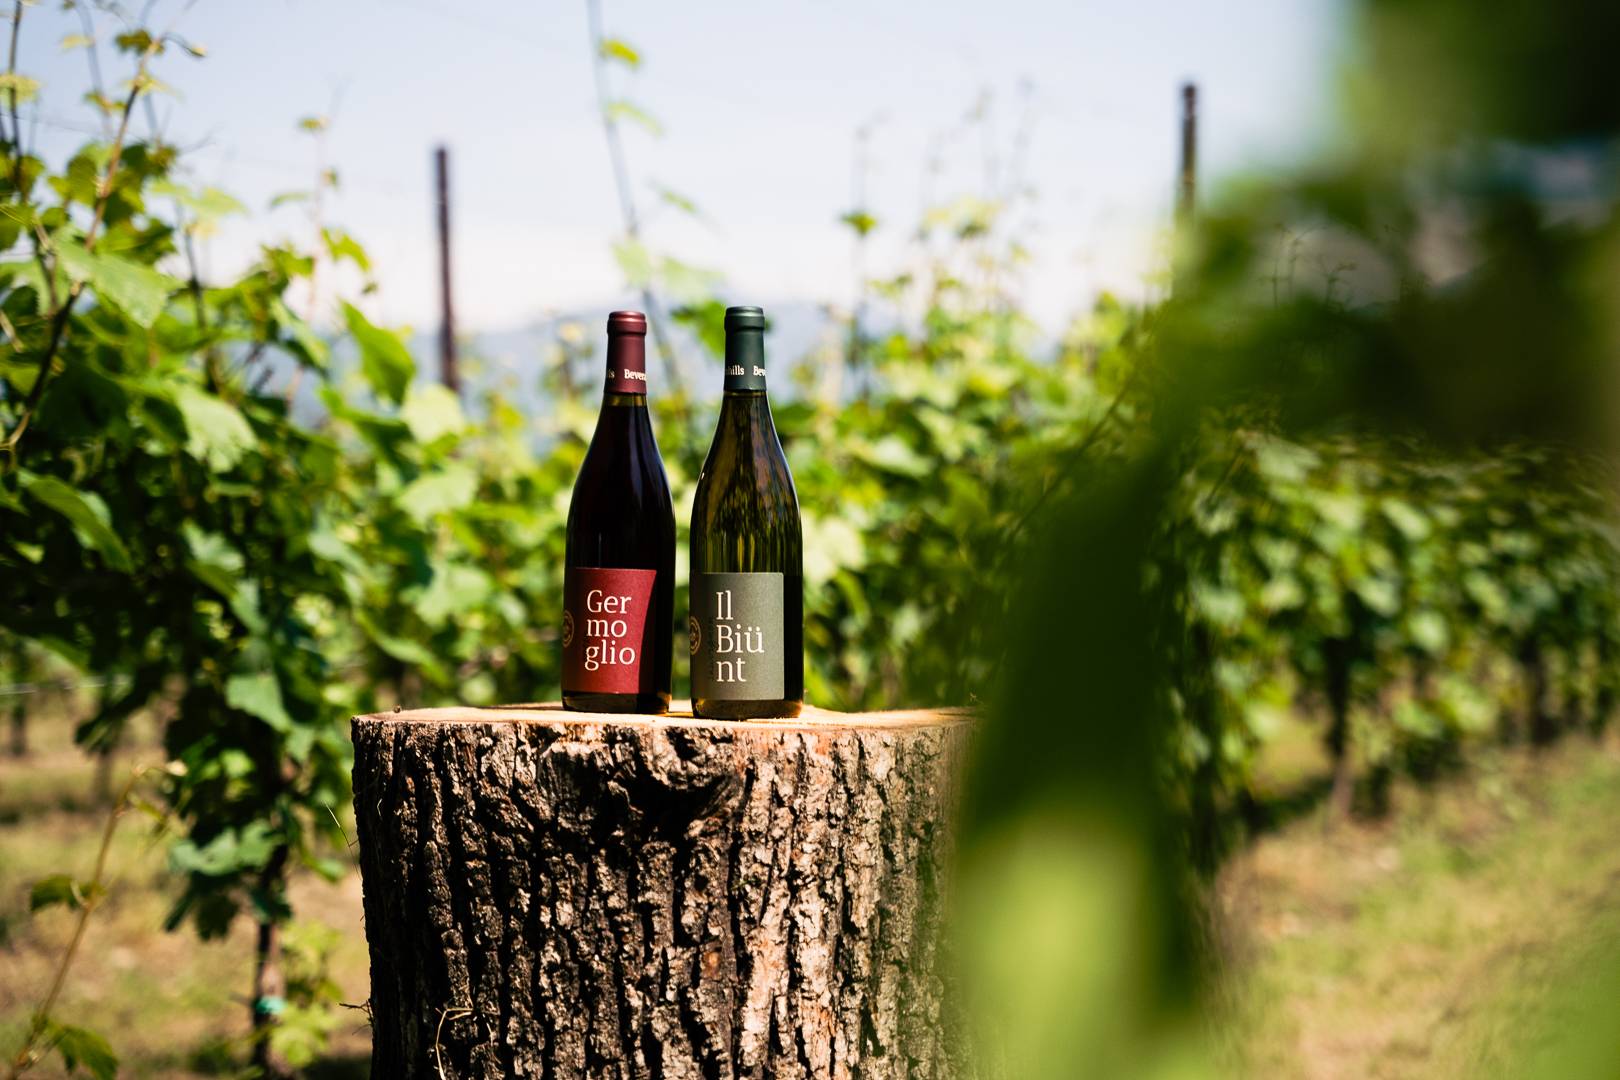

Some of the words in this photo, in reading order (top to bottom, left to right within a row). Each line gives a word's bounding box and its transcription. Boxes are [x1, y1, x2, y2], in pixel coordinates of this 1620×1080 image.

[586, 589, 632, 614] Ger
[716, 590, 734, 620] Il
[586, 618, 627, 638] mo
[716, 623, 765, 653] Biü
[584, 639, 636, 671] glio
[716, 658, 747, 682] nt
